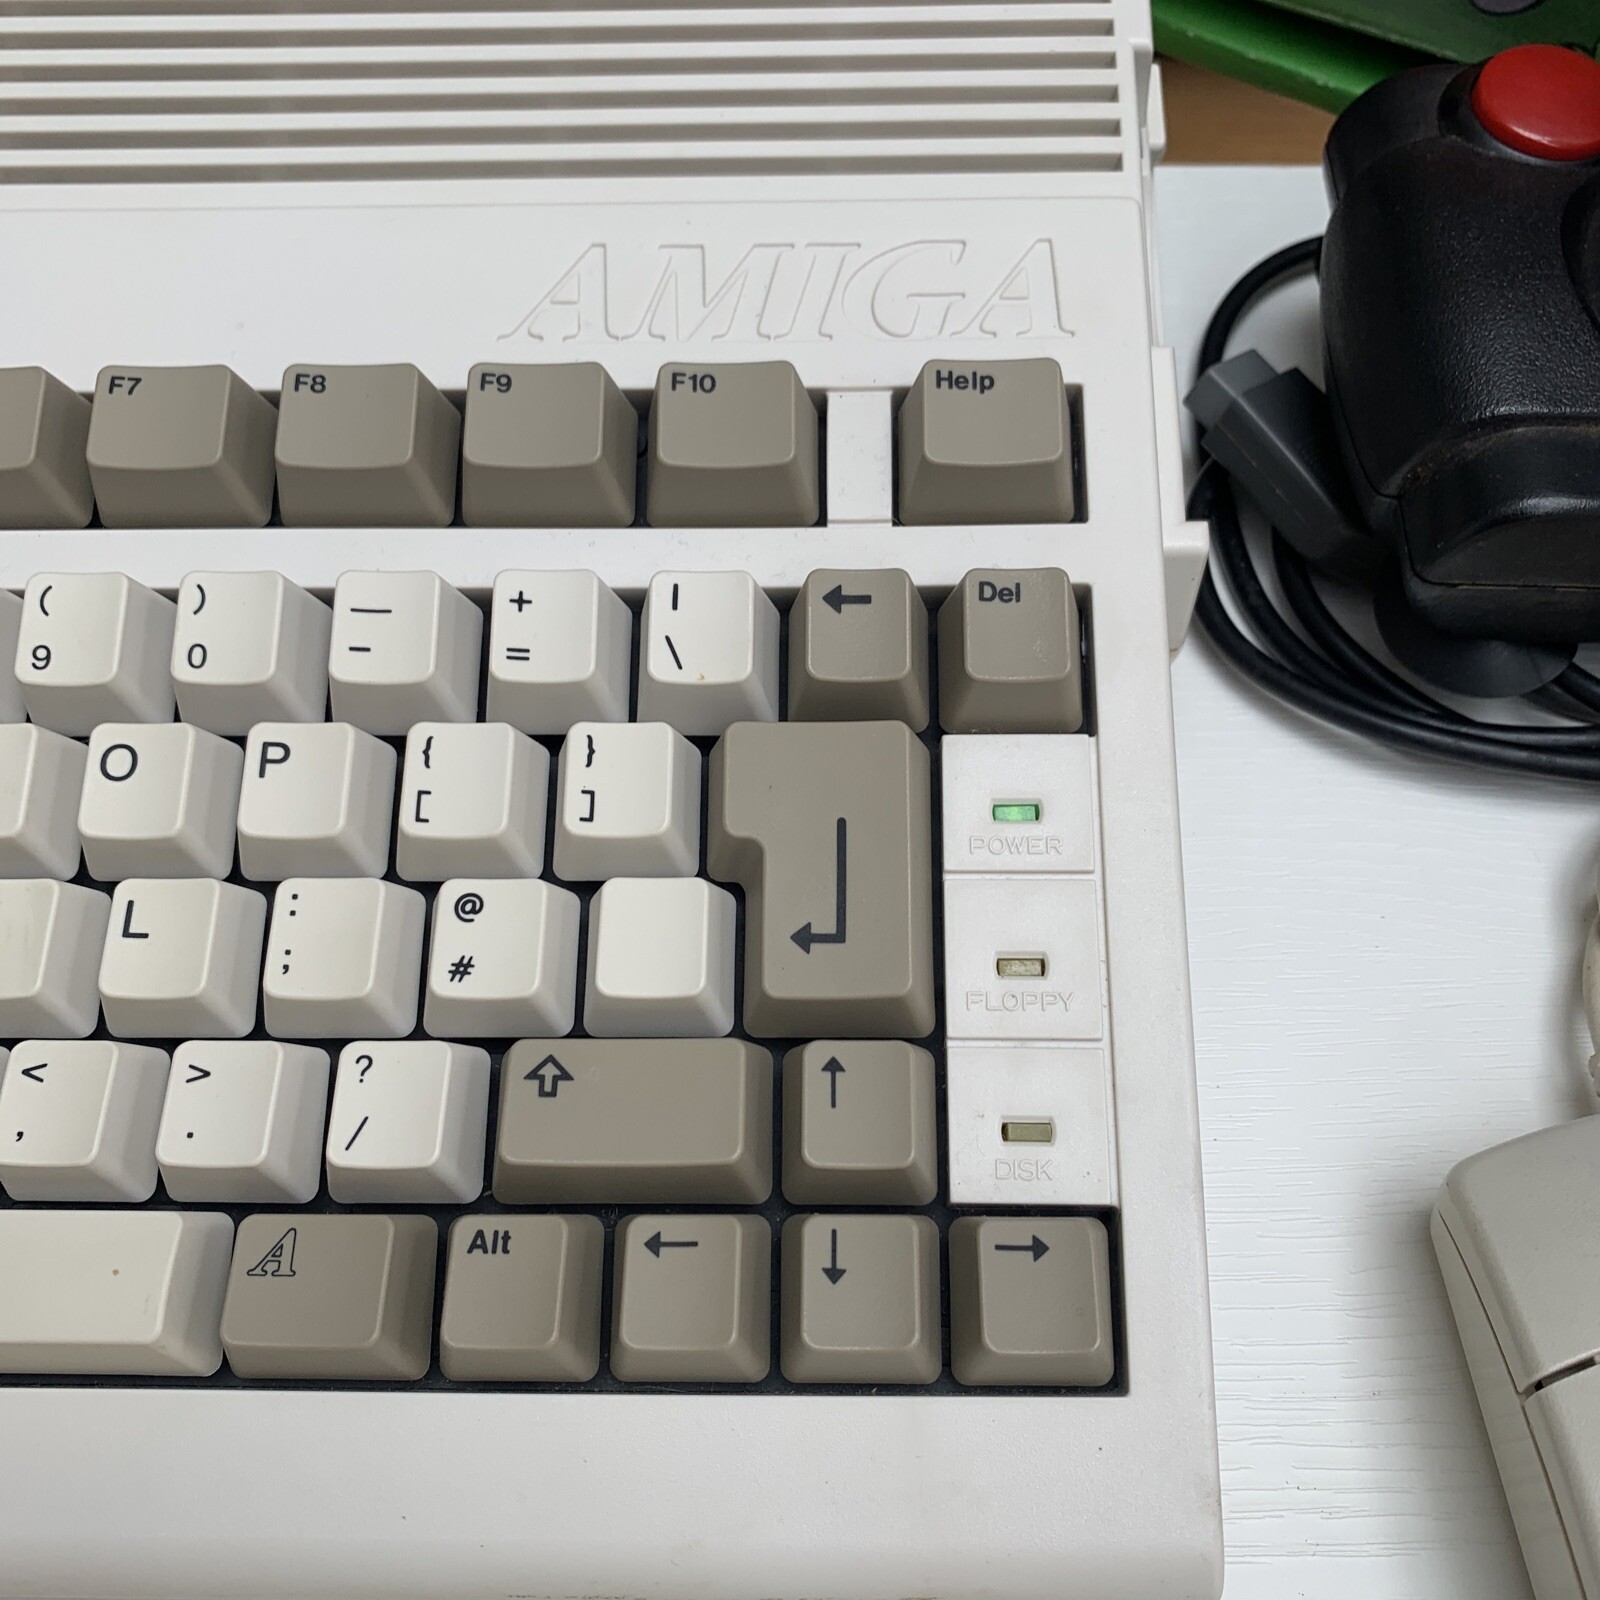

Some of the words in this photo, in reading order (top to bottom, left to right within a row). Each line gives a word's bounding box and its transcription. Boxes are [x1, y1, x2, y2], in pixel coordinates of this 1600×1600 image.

[497, 239, 1075, 342] AMIGA
[108, 375, 143, 396] F7
[294, 373, 327, 394] F8
[479, 372, 513, 394] F9
[671, 371, 717, 394] F10
[935, 369, 995, 395] Help
[39, 585, 53, 617] (
[193, 583, 206, 616] )
[508, 590, 533, 613] +
[978, 580, 1021, 604] Del
[31, 644, 52, 671] 9
[505, 647, 531, 662] =
[99, 743, 139, 783] O
[258, 741, 291, 779] P
[422, 735, 434, 769] {
[585, 734, 596, 768] }
[414, 789, 432, 824] [
[578, 789, 596, 823] ]
[969, 836, 1062, 855] POWER
[289, 893, 299, 917] :
[453, 892, 485, 923] @
[121, 899, 150, 940] L
[282, 949, 292, 975] ;
[447, 954, 475, 983] #
[966, 991, 1075, 1012] FLOPPY
[21, 1062, 48, 1083] <
[185, 1064, 212, 1084] >
[355, 1054, 374, 1084] ?
[344, 1116, 369, 1151] /
[995, 1158, 1054, 1181] DISK
[466, 1228, 512, 1255] Alt
